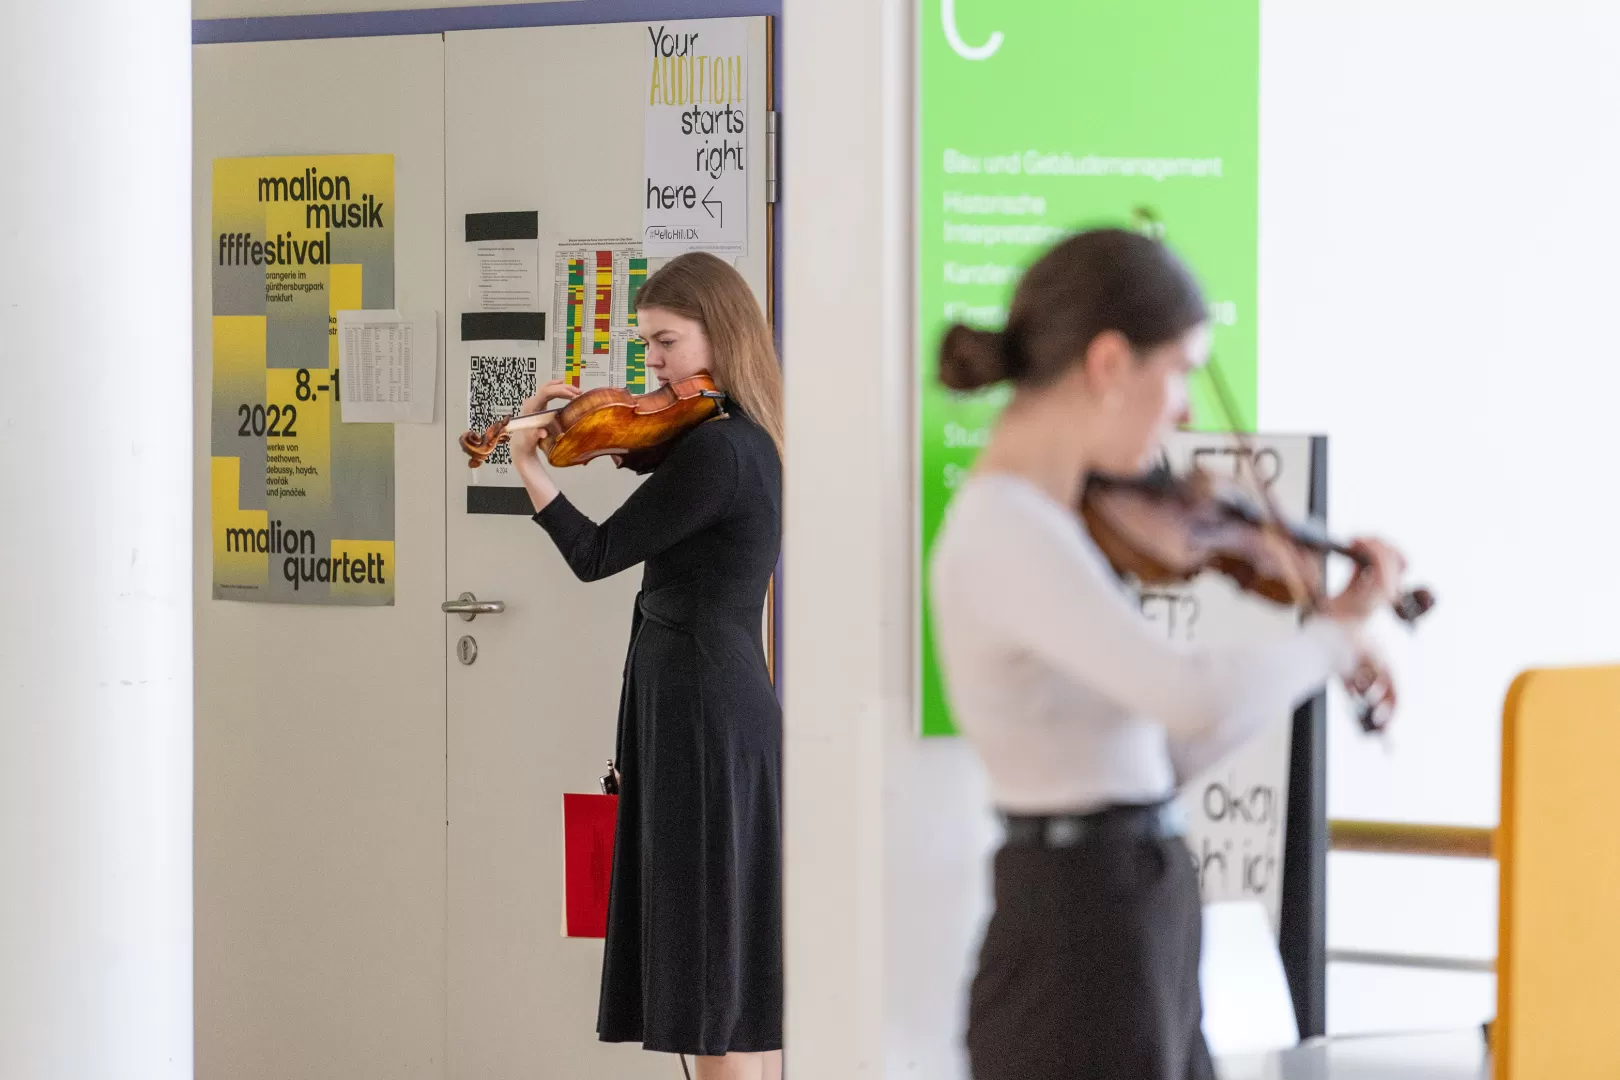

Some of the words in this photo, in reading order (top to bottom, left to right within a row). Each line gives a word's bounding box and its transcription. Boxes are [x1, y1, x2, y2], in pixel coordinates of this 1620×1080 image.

[648, 25, 699, 57] Your
[650, 56, 742, 106] AUDITION
[681, 104, 744, 135] starts
[696, 139, 744, 179] right
[983, 153, 1021, 174] und
[258, 167, 351, 202] malion
[646, 178, 697, 209] here
[306, 194, 384, 229] musik
[266, 270, 296, 281] orangerie
[298, 270, 307, 279] im
[266, 282, 324, 293] günthersburgpark
[266, 294, 293, 302] frankfurt
[238, 404, 297, 437] 2022
[266, 465, 295, 476] debussy,
[295, 465, 318, 476] haydn,
[267, 454, 302, 464] beethoven,
[266, 487, 279, 496] und
[226, 520, 316, 554] malion
[283, 552, 385, 590] quartett
